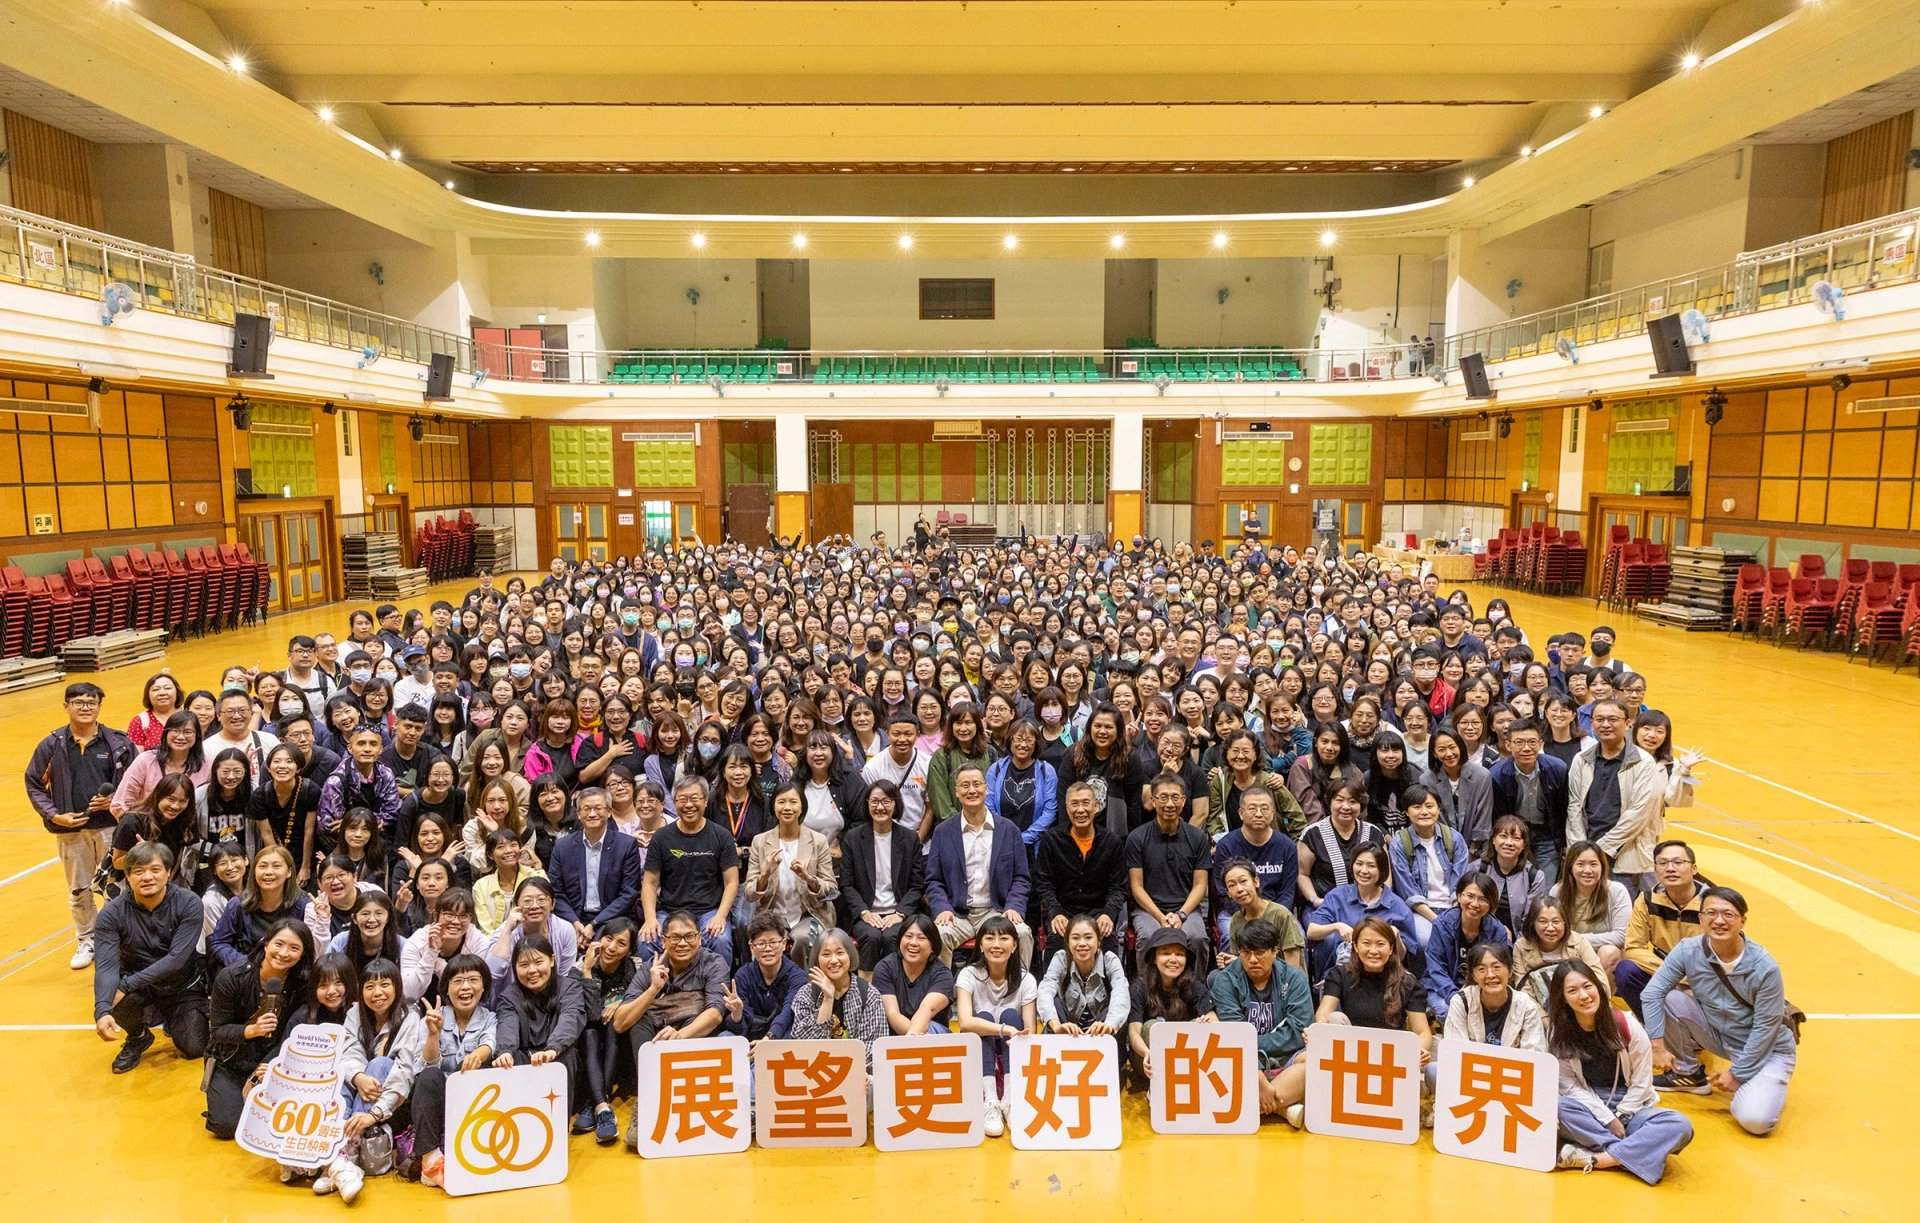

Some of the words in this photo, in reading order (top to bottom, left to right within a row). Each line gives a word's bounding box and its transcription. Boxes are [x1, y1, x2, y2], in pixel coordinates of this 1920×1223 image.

[34, 249, 54, 265] 北區
[651, 1048, 738, 1144] 展
[766, 1050, 854, 1138] 望
[886, 1045, 972, 1138] 更
[1022, 1045, 1108, 1138] 好
[1165, 1033, 1243, 1124] 的
[1319, 1039, 1407, 1131] 世
[1449, 1052, 1543, 1153] 界
[273, 1100, 321, 1136] 60
[286, 1136, 330, 1153] 生日快樂
